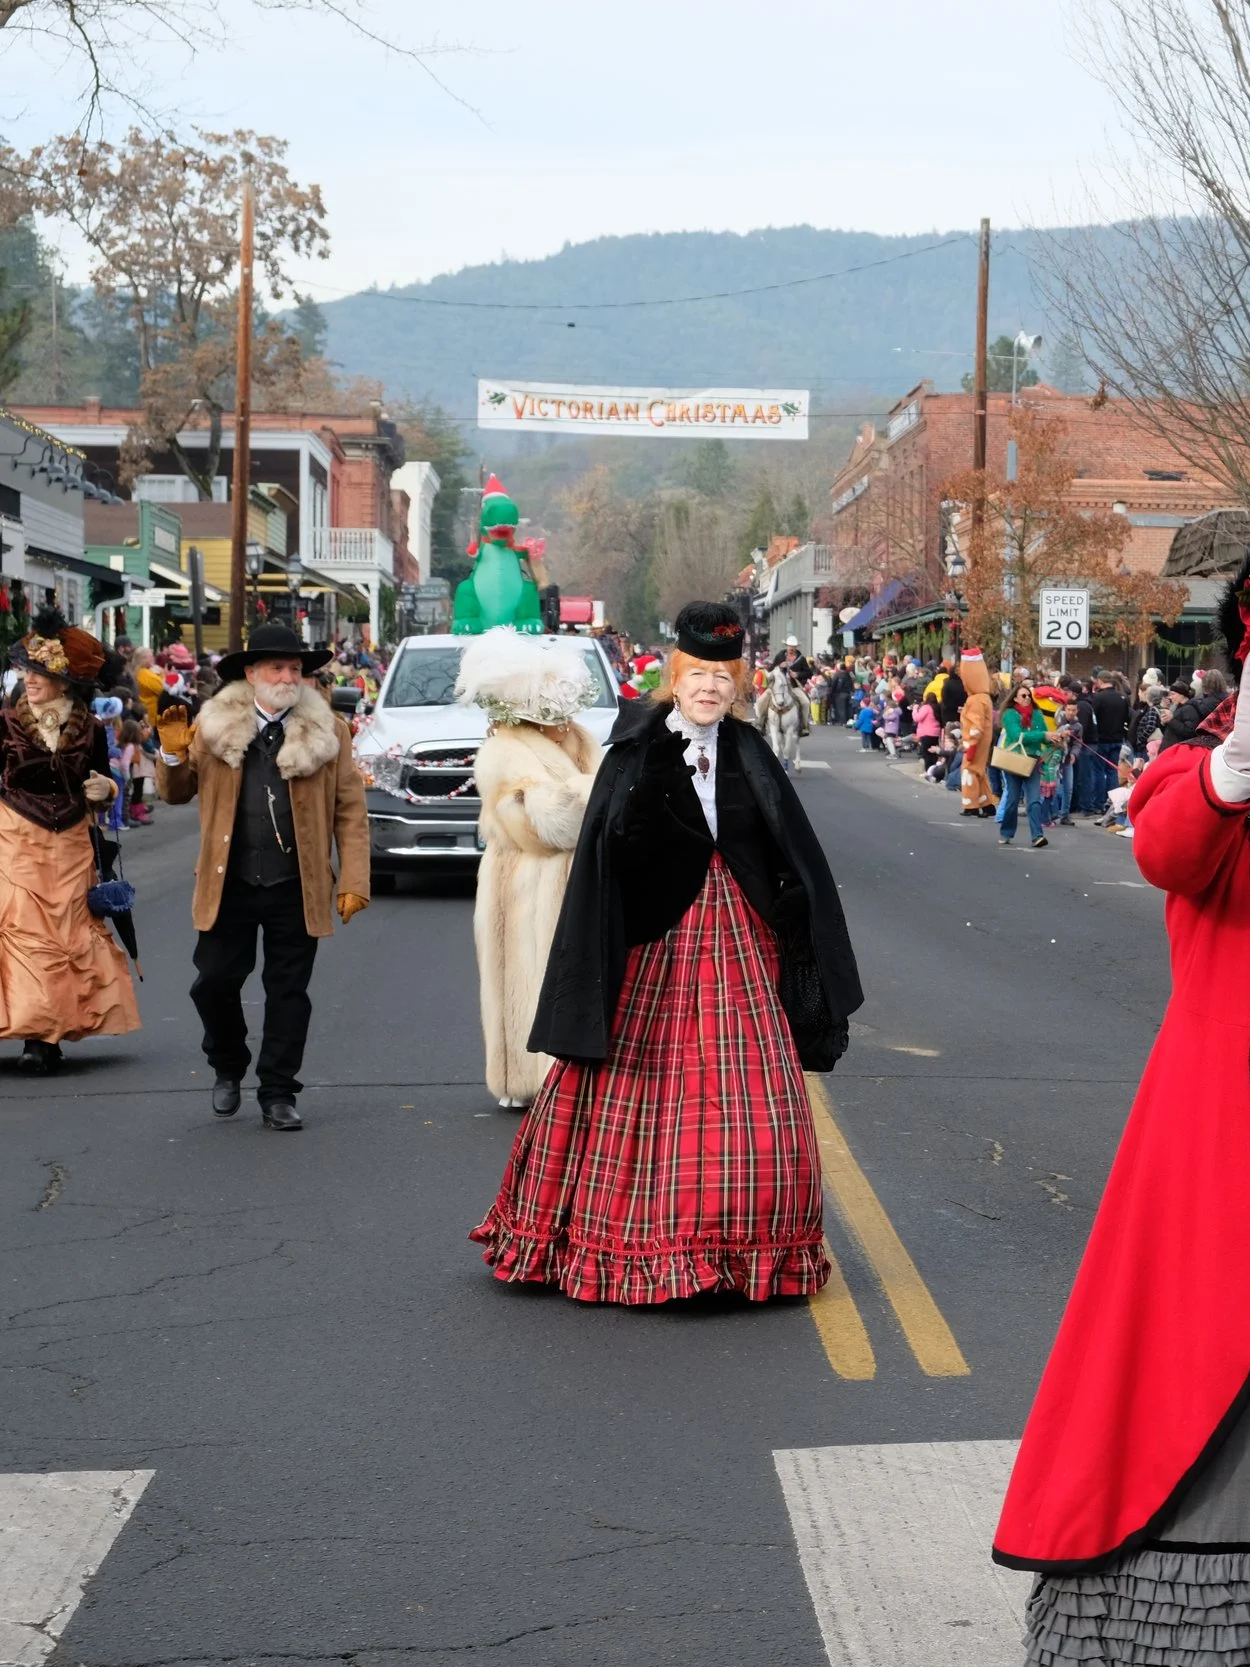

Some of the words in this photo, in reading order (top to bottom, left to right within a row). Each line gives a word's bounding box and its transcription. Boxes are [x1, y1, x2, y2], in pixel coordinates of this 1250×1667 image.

[511, 394, 639, 421] VICTORIAN
[647, 399, 783, 427] CHRISTMAS
[1045, 595, 1084, 605] SPEED
[1048, 607, 1080, 617] LIMIT
[1046, 620, 1082, 640] 20
